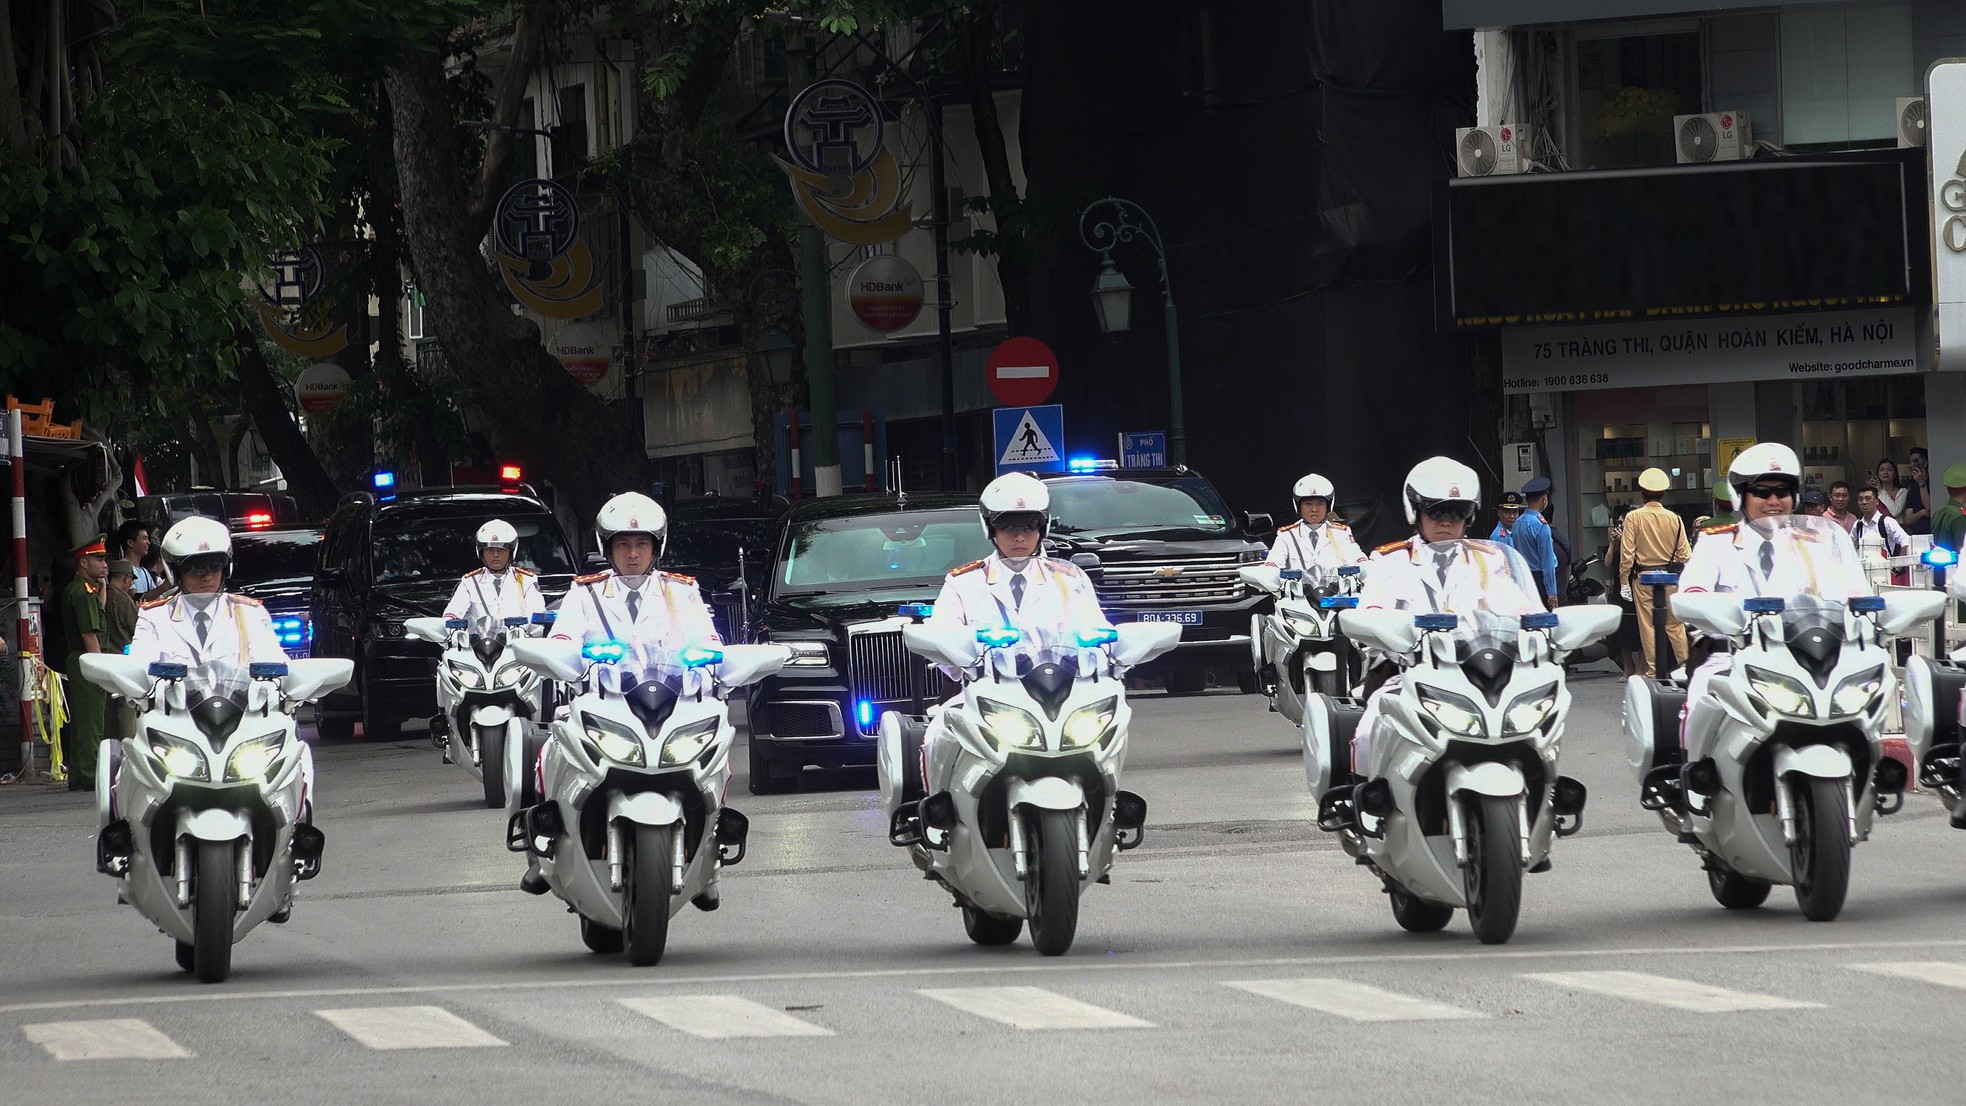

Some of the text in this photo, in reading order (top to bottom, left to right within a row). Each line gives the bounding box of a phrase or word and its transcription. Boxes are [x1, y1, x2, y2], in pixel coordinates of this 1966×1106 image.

[1723, 131, 1732, 139] LG
[860, 281, 904, 292] HDBank
[1533, 319, 1894, 359] 75 TRÀNG THI, QUẬN HOÀN KIẾM, HÀ NỘI
[1789, 358, 1914, 373] Website: goodcharme.vn
[1504, 372, 1609, 388] Hotline: 1900 636 638
[1140, 436, 1154, 446] PHỐ
[1127, 452, 1164, 468] TRÀNG THI
[1143, 613, 1197, 622] 80A-336.69
